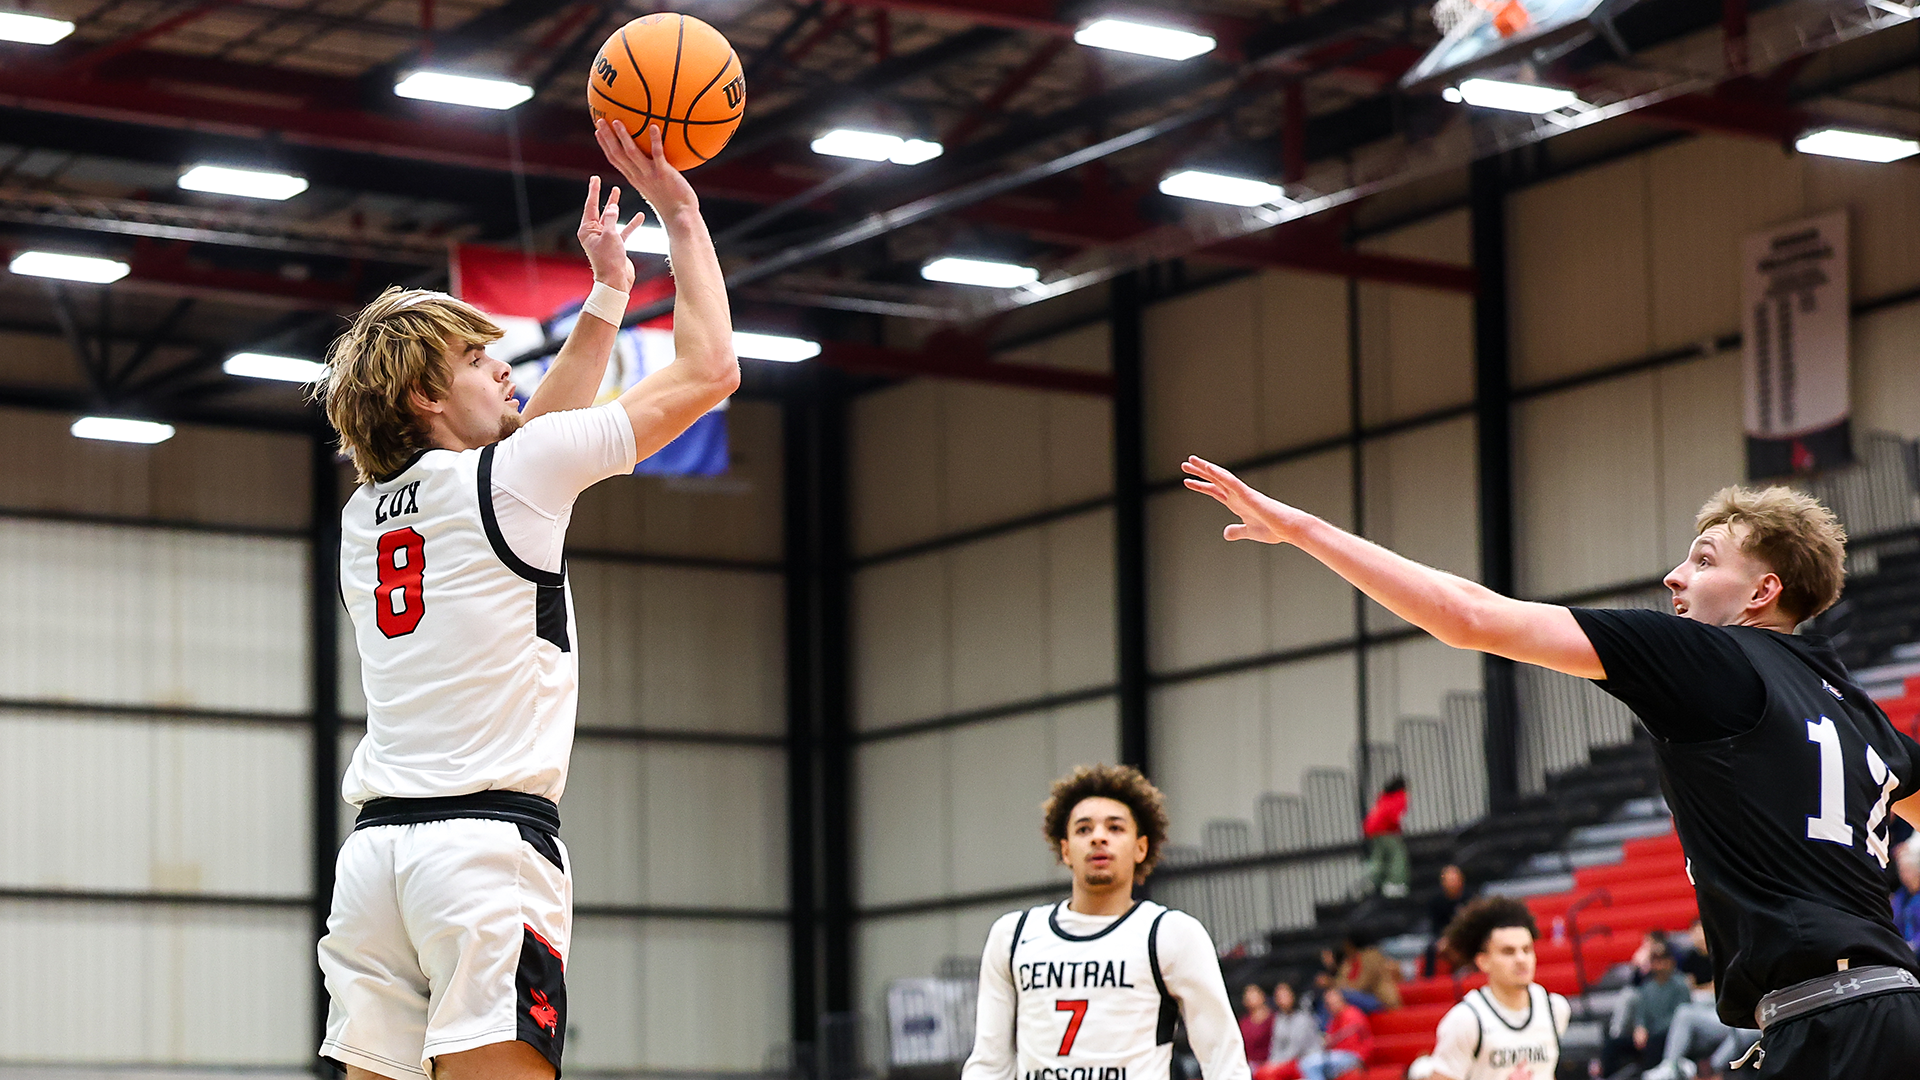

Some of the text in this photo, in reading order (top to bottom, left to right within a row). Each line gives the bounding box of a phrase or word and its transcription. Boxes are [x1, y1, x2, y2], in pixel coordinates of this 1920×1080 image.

[375, 480, 421, 526] LUX
[374, 526, 427, 640] 8
[1019, 960, 1135, 991] CENTRAL
[1055, 999, 1089, 1057] 7
